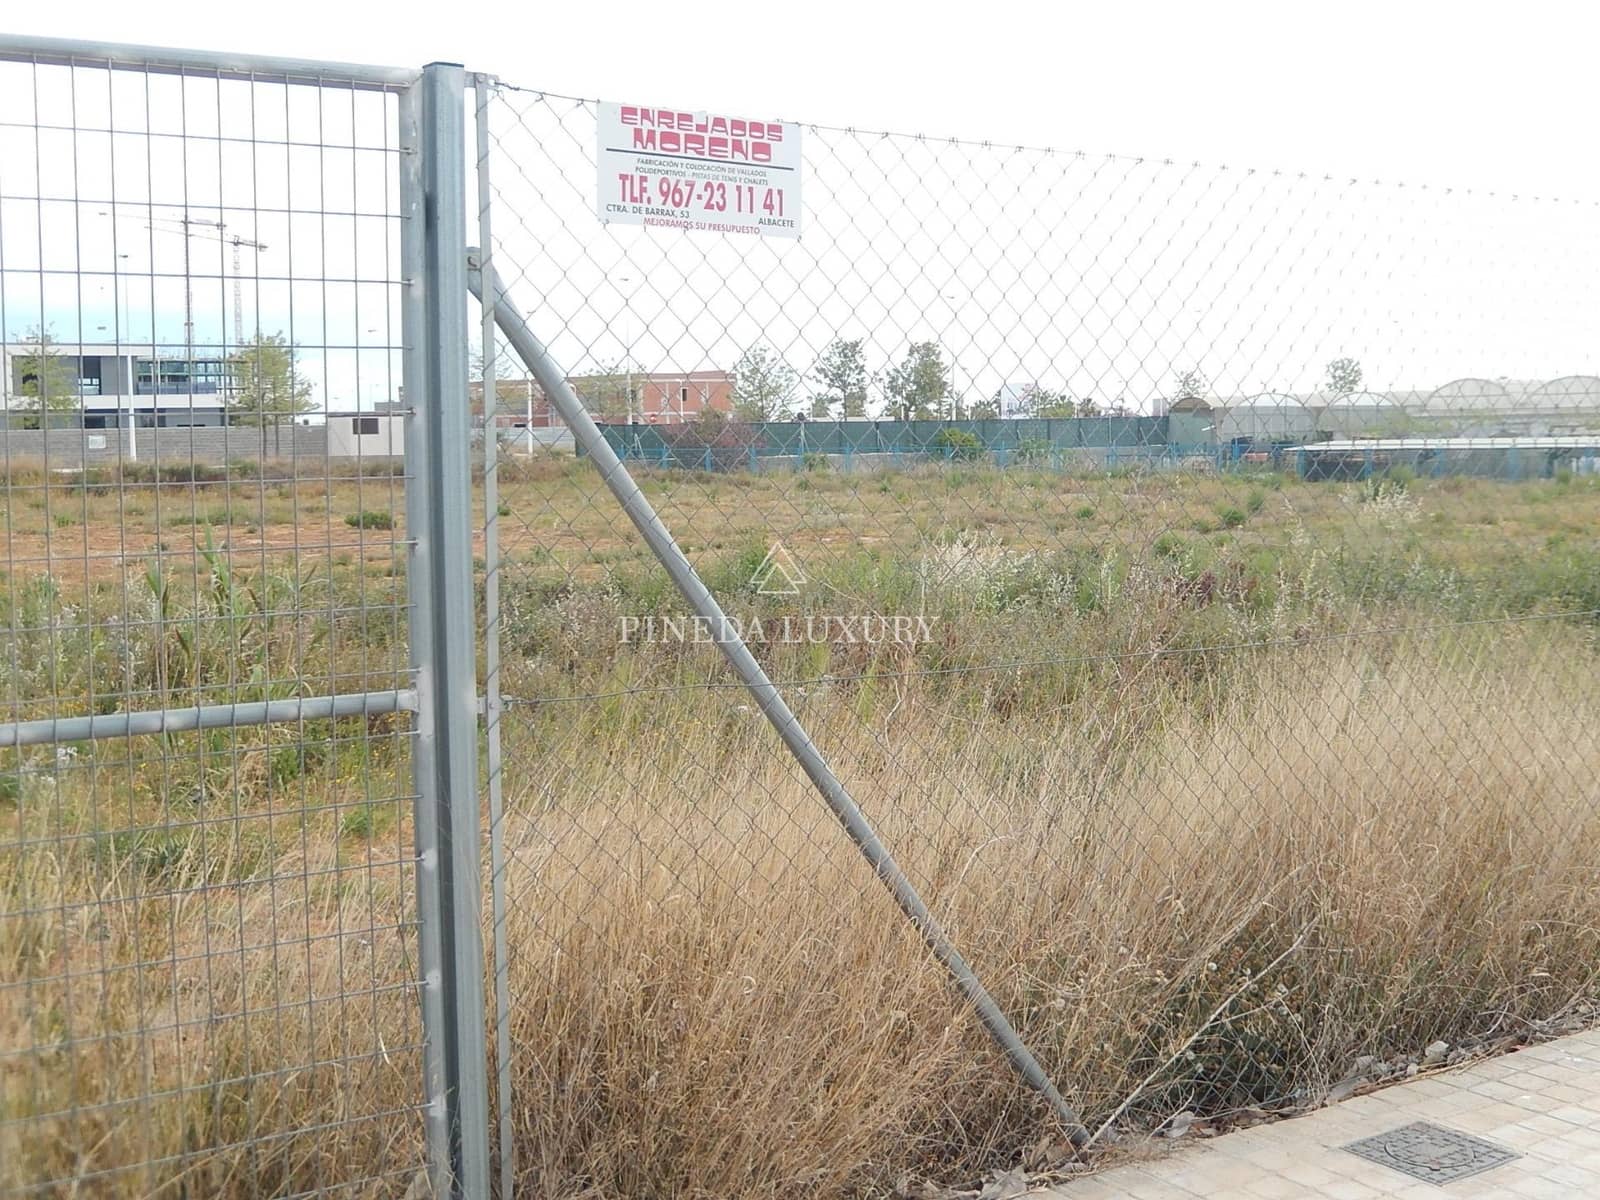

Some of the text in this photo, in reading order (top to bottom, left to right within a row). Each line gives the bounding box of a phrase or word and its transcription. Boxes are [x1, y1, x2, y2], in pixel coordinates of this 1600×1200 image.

[621, 106, 783, 142] ENREJADOS
[633, 128, 772, 162] MORENO
[635, 166, 686, 177] POLIDEPORTIVOS
[721, 175, 737, 183] TENIS
[743, 177, 768, 186] CHALETS
[637, 158, 679, 168] FABRICACIÓN
[685, 163, 726, 173] COLOCACIÓN
[737, 167, 767, 177] VALLADOS
[618, 173, 784, 217] TLF. 967-23 11 41
[606, 203, 629, 213] CTRA.
[632, 206, 644, 214] DE
[645, 207, 678, 218] BARRAX,
[758, 217, 795, 228] ALBACETE
[643, 217, 760, 235] MEJORAMOS SU PRESUPUESTO
